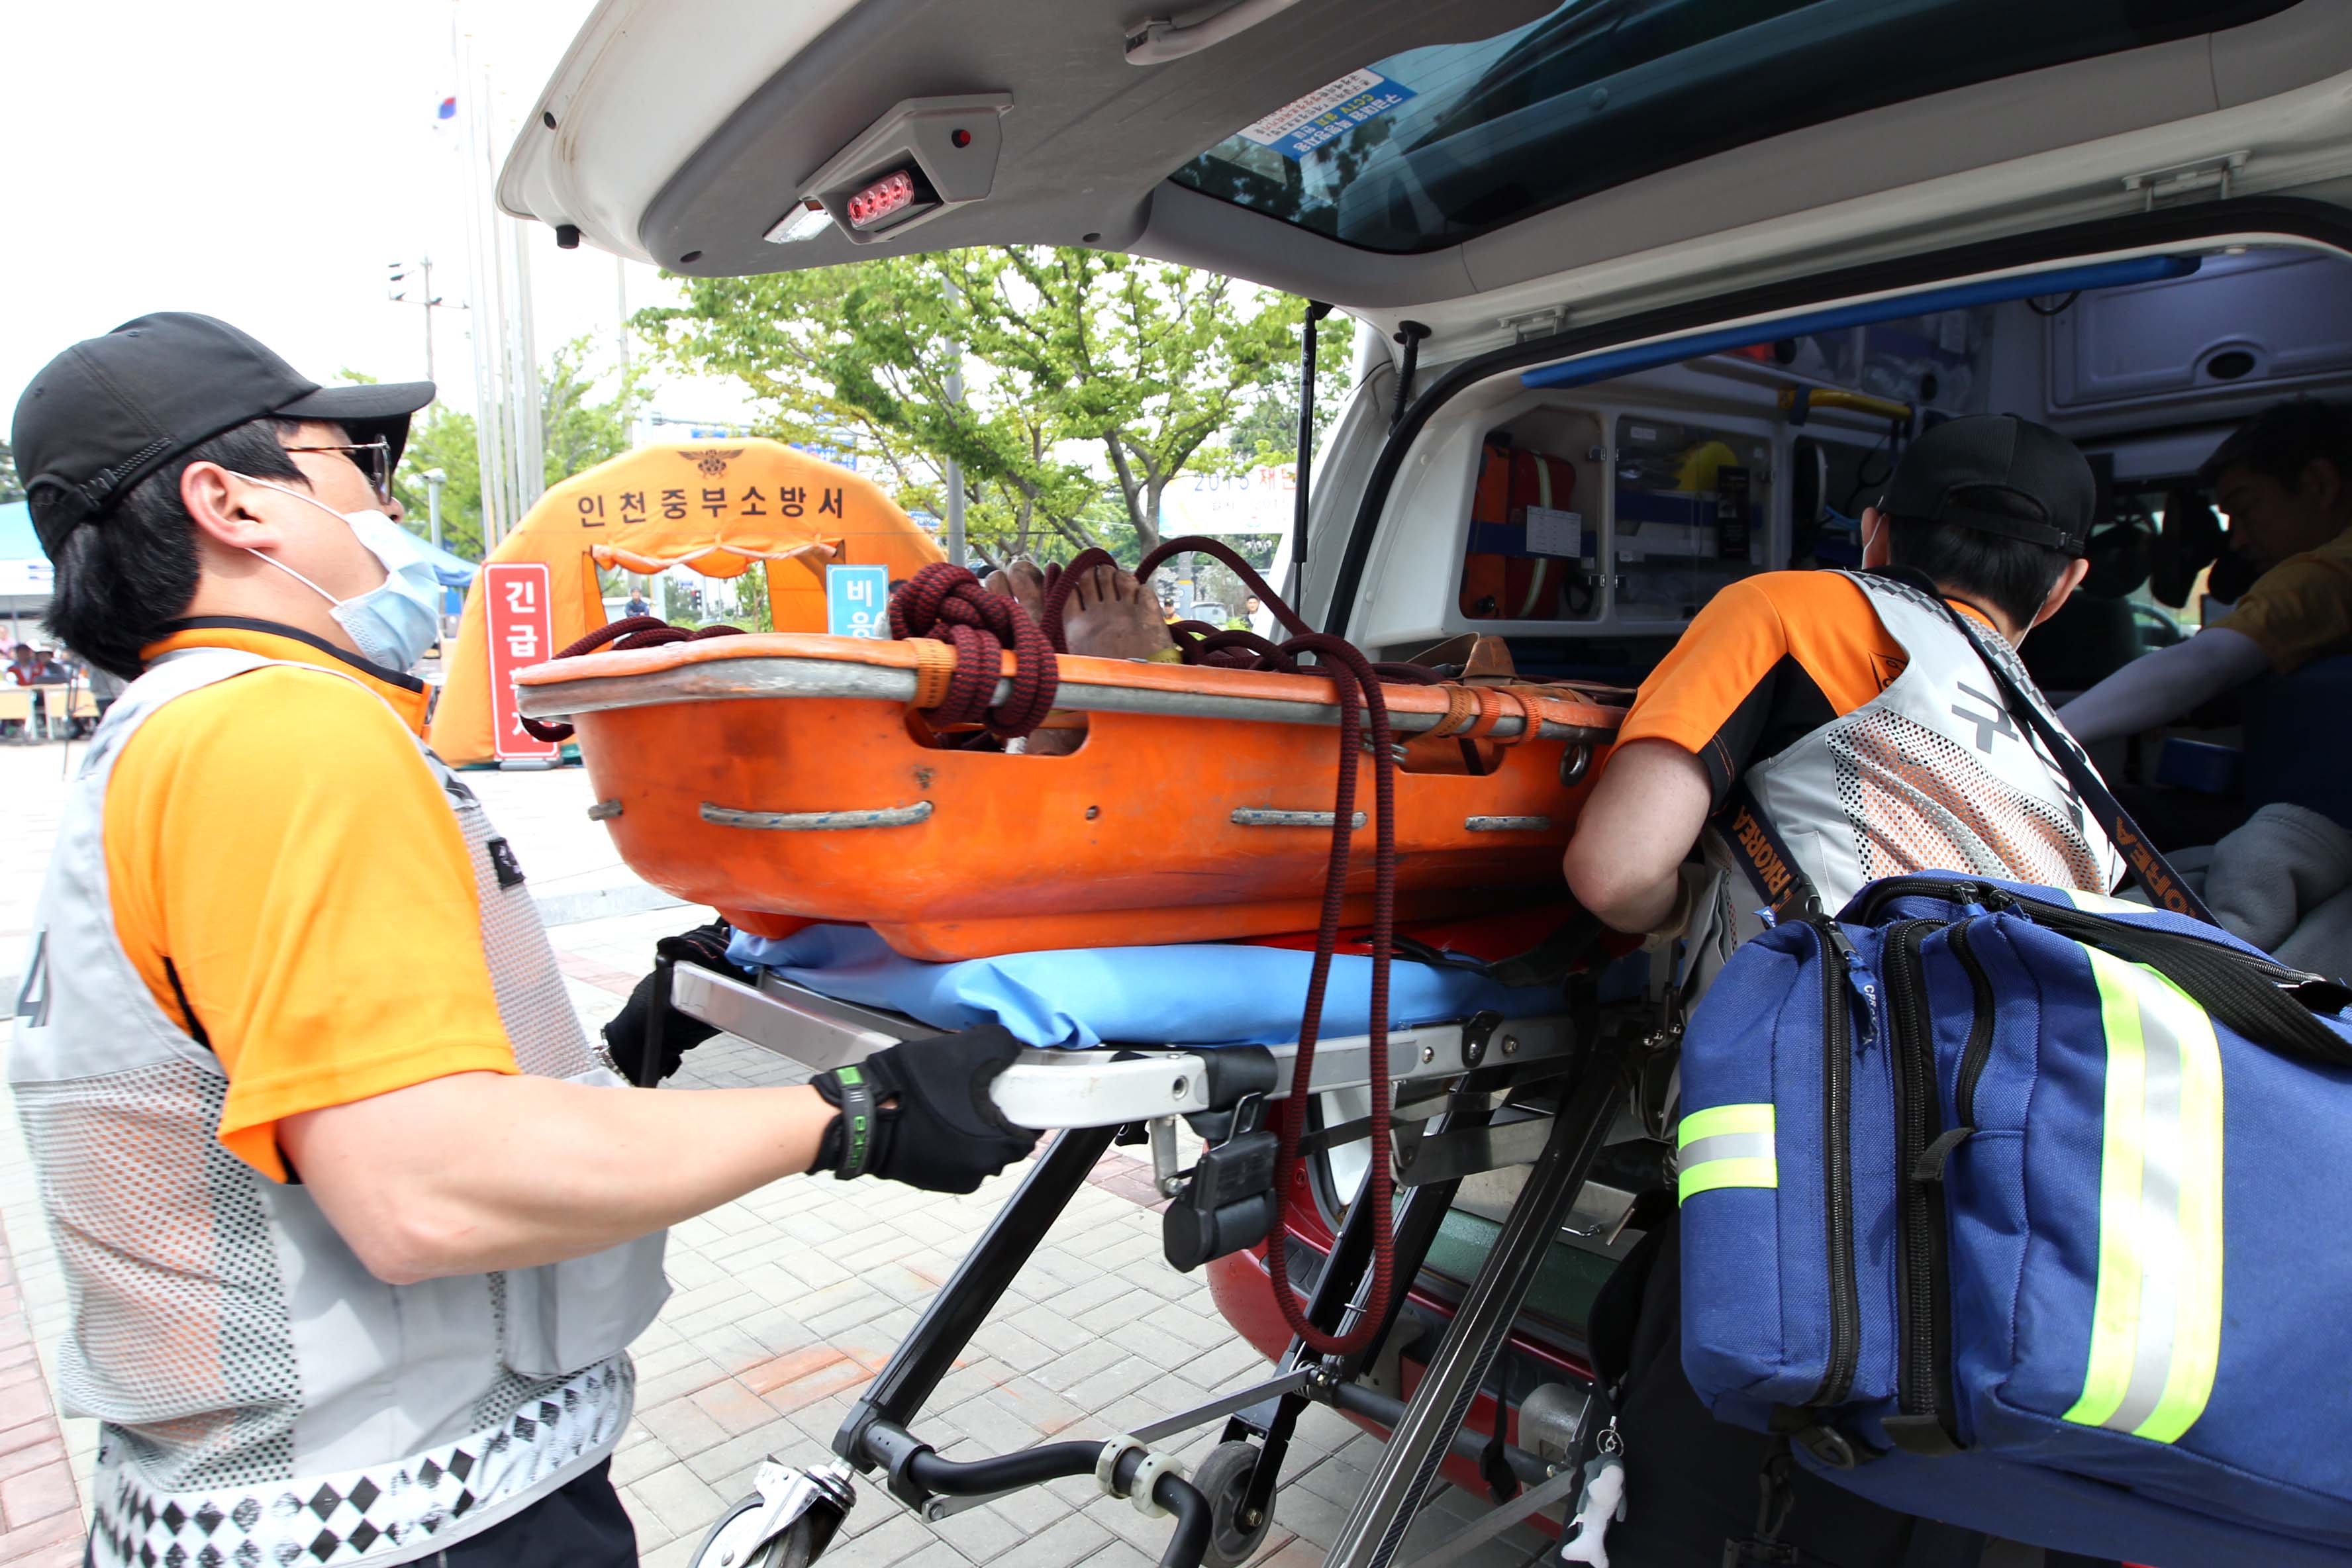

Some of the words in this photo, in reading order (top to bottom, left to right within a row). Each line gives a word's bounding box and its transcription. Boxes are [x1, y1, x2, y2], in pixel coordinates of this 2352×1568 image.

[1337, 94, 1375, 113] CCTV
[577, 487, 843, 528] 인천중부소방서
[505, 581, 539, 742] 긴급
[2116, 816, 2197, 918] OREA
